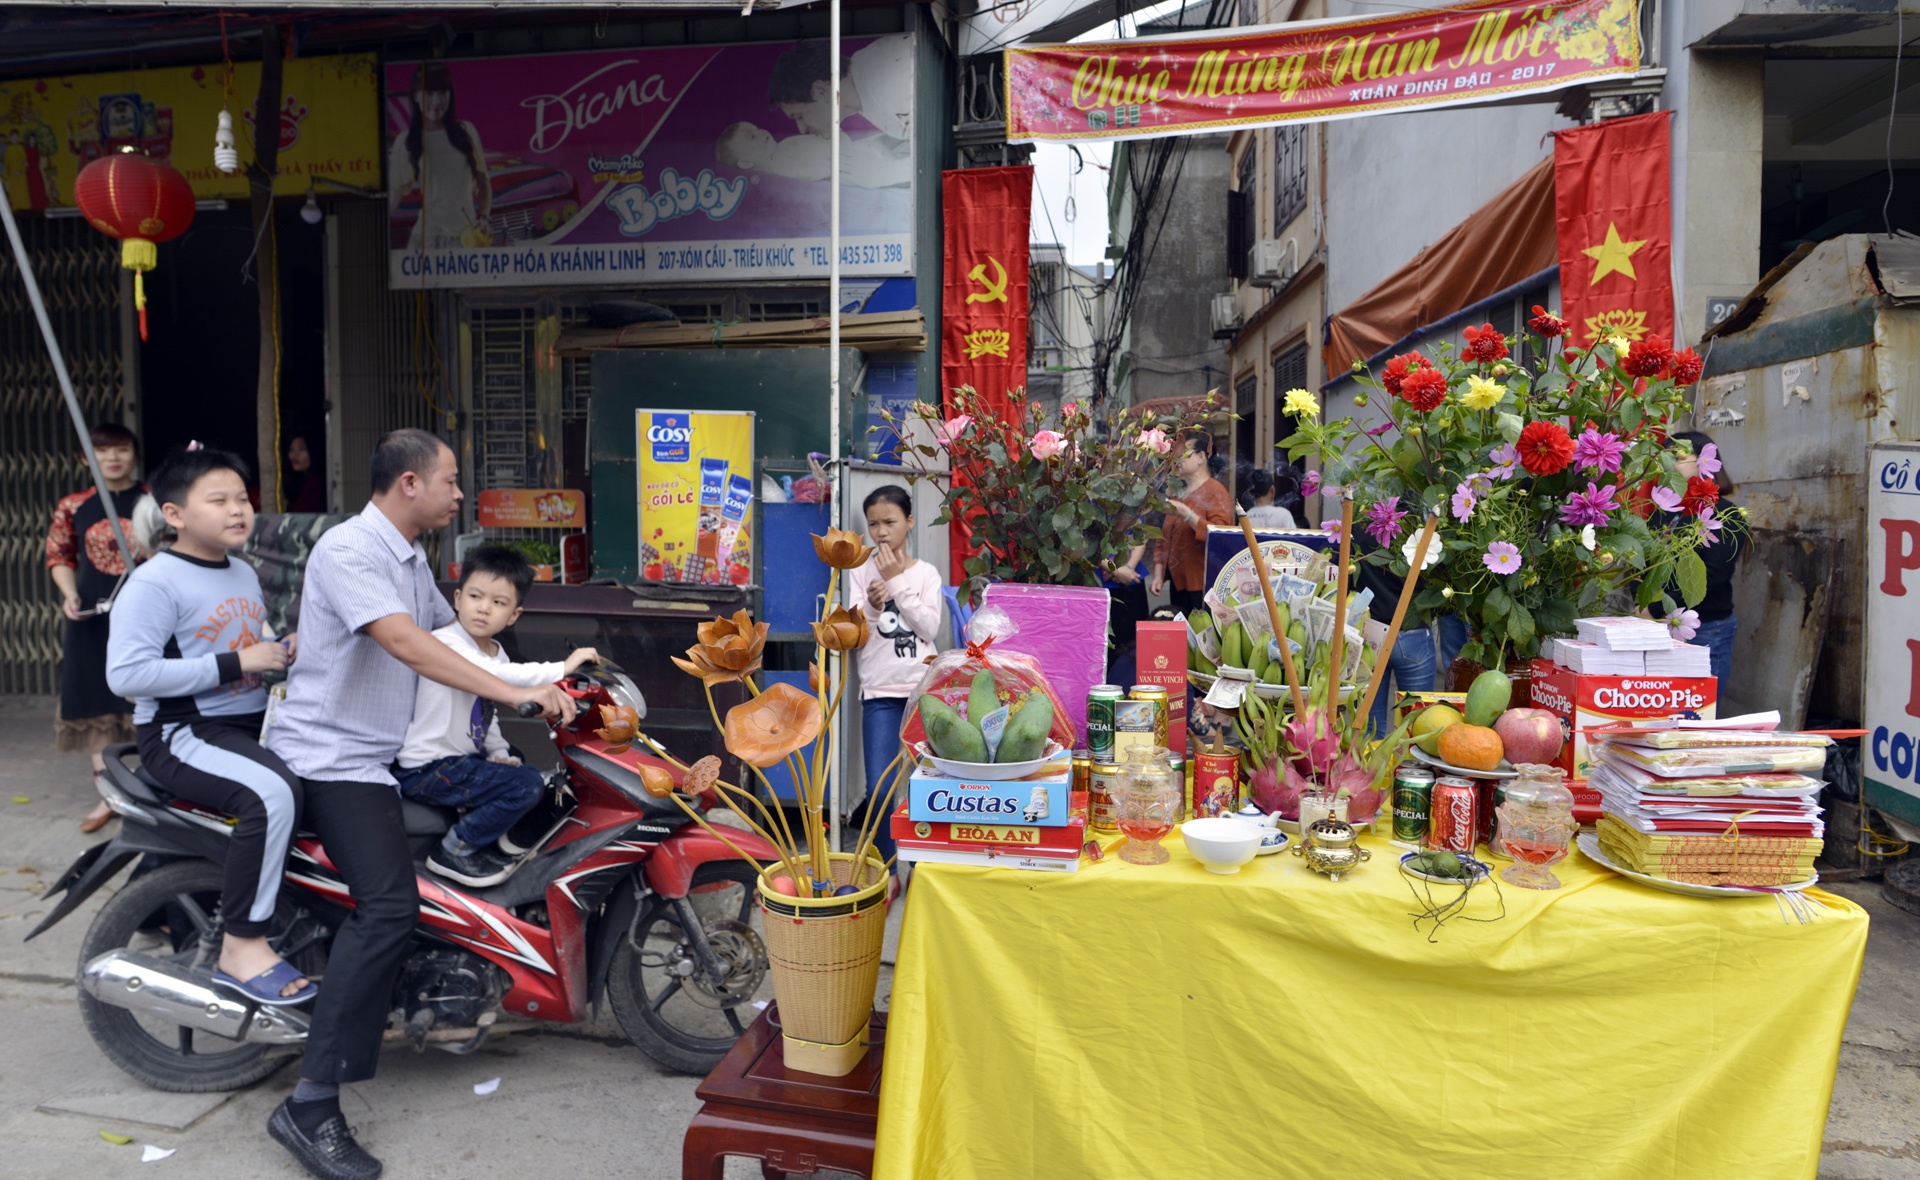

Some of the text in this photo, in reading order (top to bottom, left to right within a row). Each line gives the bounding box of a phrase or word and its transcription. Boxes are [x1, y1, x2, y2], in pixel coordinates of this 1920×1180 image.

[1070, 6, 1553, 111] Chúc Mừng Năm Mới
[1350, 83, 1398, 101] XUÂN
[1404, 77, 1448, 96] ĐINH
[1454, 71, 1491, 90] ĐẬU
[1511, 62, 1557, 81] 2017
[519, 59, 672, 154] Diana
[349, 156, 372, 171] TẾT
[606, 167, 748, 237] Bobby
[401, 250, 432, 275] CỬA
[436, 251, 479, 275] HÀNG
[483, 253, 510, 279] TẠP
[513, 248, 547, 273] HÓA
[551, 247, 605, 272] KHÁNH
[609, 250, 646, 271] LINH
[765, 244, 795, 267] KHÚC
[839, 246, 861, 265] 435
[863, 245, 880, 264] 521
[883, 243, 903, 263] 398
[646, 425, 695, 443] COSY
[1880, 458, 1911, 490] Cồ
[701, 484, 722, 494] COSY
[725, 496, 746, 511] COSY
[1139, 675, 1184, 684] VAN DE VINCH
[1543, 681, 1558, 694] ORION
[1633, 680, 1670, 690] ORION
[1169, 699, 1184, 711] WINE
[1872, 725, 1920, 785] CƠ
[927, 789, 1019, 815] Custas
[1393, 807, 1428, 820] SPECIAL
[636, 824, 671, 833] HONDA
[956, 826, 1034, 843] HÒA AN
